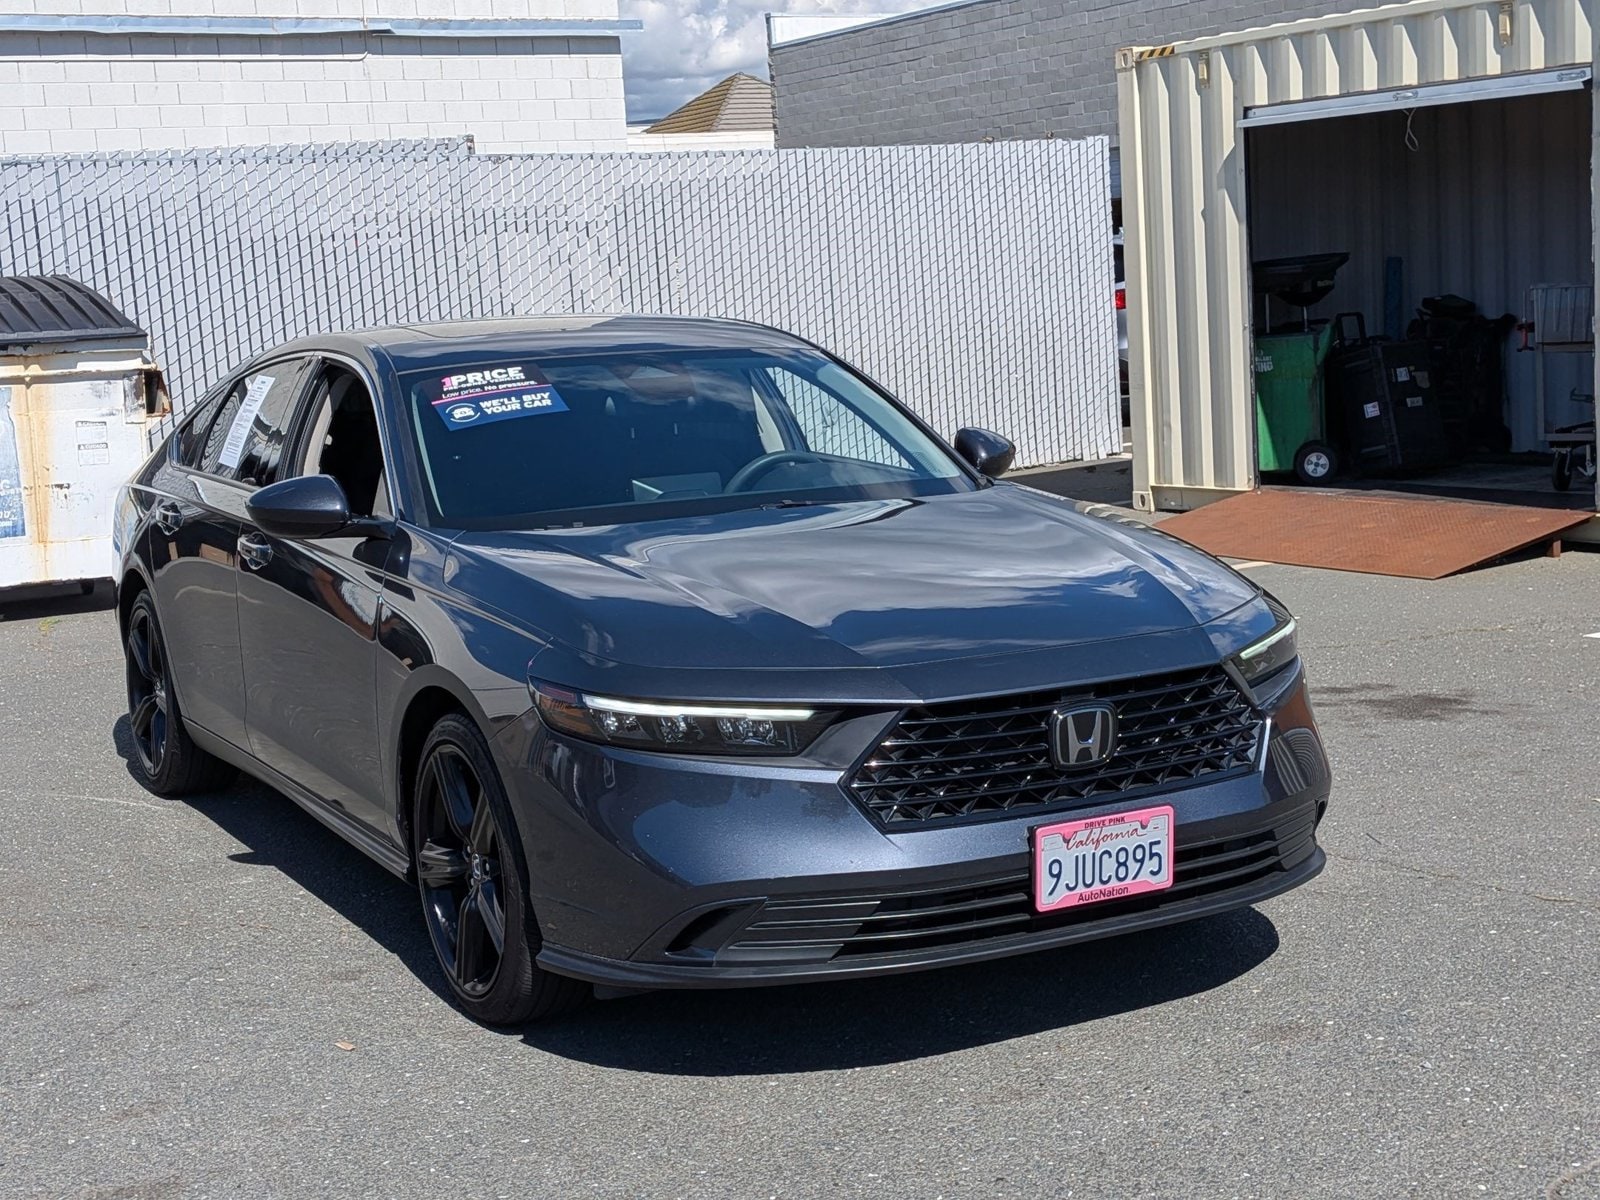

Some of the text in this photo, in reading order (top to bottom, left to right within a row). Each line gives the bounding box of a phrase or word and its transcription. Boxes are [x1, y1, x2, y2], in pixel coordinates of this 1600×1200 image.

[441, 366, 523, 388] 1PRICE
[442, 392, 459, 400] Low
[461, 387, 483, 396] price.
[499, 380, 537, 389] pressure.
[479, 392, 550, 408] WE'LL BUY
[483, 399, 552, 415] YOUR CAR
[1084, 816, 1126, 829] DRIVE PINK
[1065, 826, 1147, 851] California
[1048, 839, 1163, 897] 9JUC895
[1077, 887, 1130, 903] AutoNation
